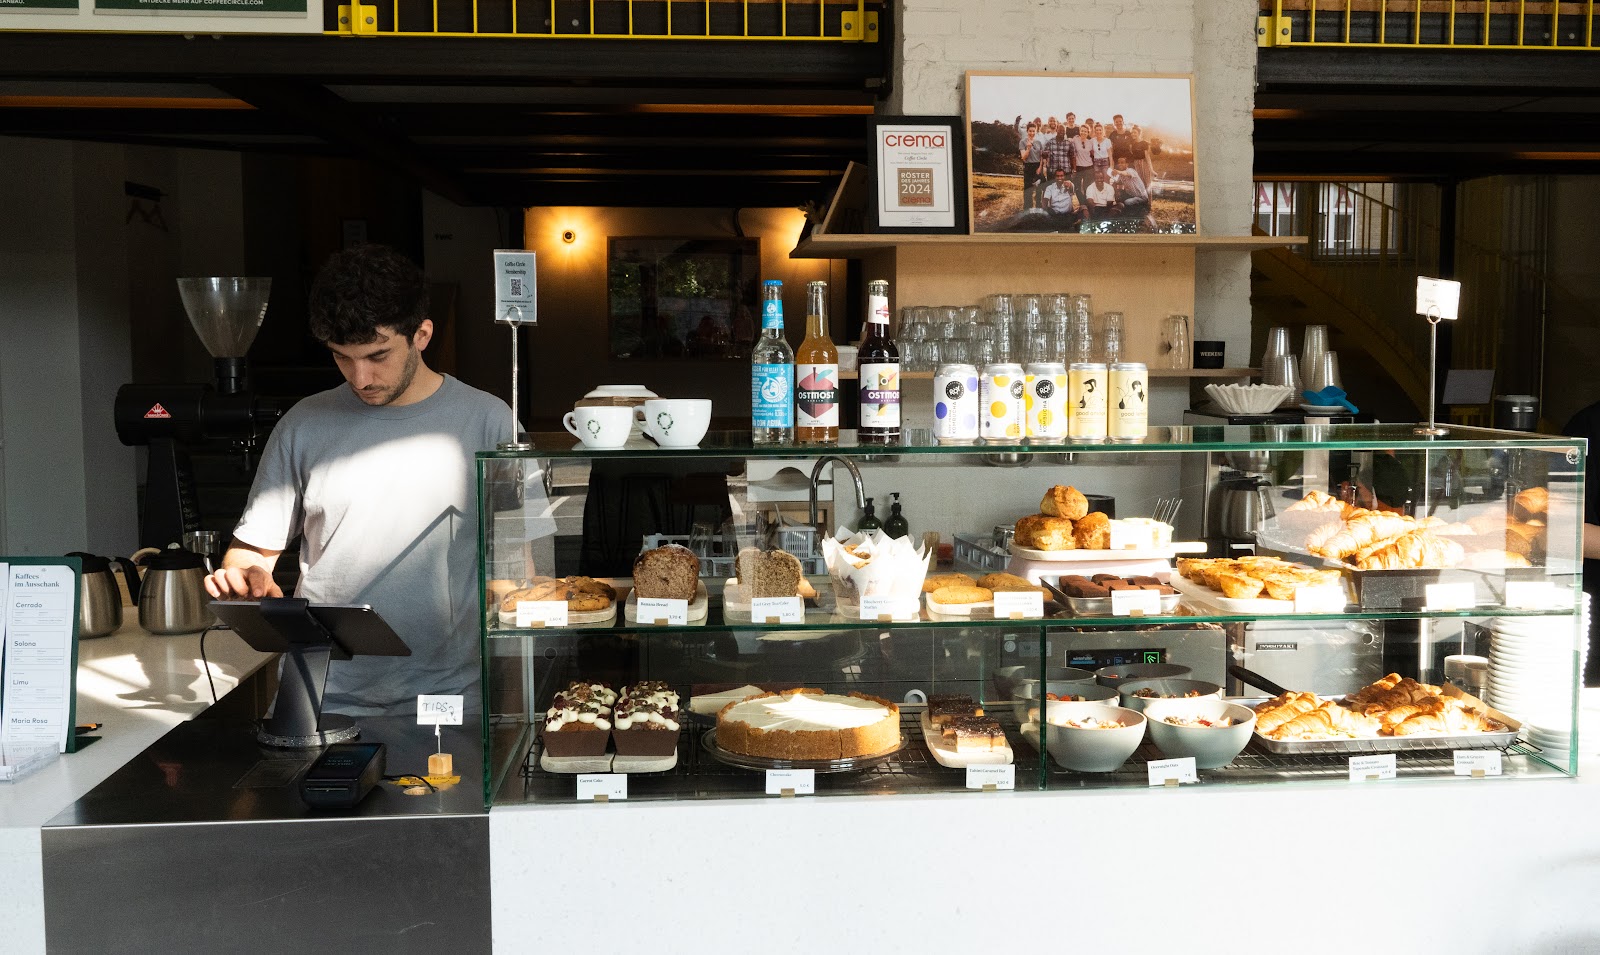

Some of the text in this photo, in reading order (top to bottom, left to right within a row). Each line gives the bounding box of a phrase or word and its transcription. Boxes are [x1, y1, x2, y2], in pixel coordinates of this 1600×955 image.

[885, 135, 945, 147] crema
[901, 171, 930, 179] RÖSTER
[901, 183, 931, 194] 2024
[901, 196, 931, 204] crema
[798, 391, 835, 399] OSTMOST
[868, 391, 900, 400] OSTMOS
